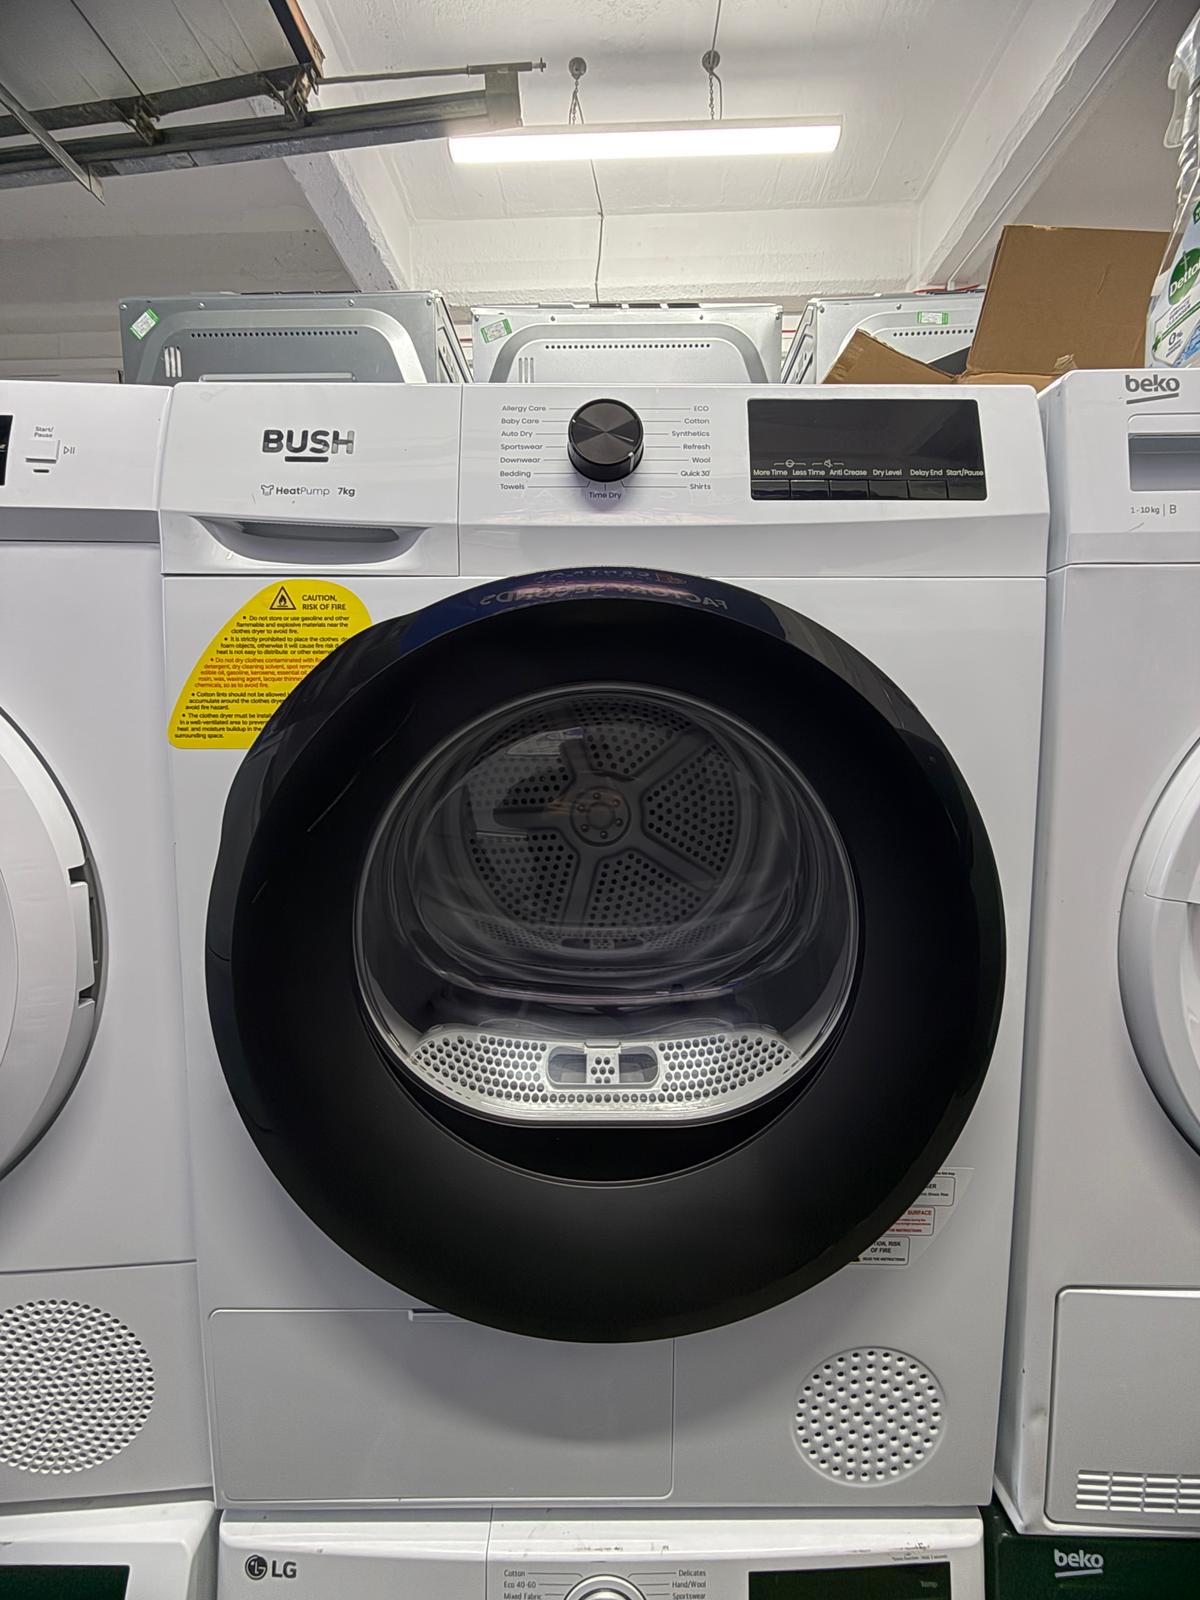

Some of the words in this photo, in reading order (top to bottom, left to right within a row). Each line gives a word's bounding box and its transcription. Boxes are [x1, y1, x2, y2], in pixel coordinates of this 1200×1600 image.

[1125, 374, 1180, 392] beko
[262, 430, 355, 454] BUSH
[872, 469, 885, 477] Dry
[910, 469, 929, 477] Delay
[946, 468, 984, 476] Start/Pause
[276, 487, 330, 496] HeatPump
[337, 487, 355, 497] 7kg
[1170, 504, 1177, 514] B
[302, 595, 337, 604] CAUTION,
[1054, 1549, 1104, 1568] beko
[272, 1560, 297, 1578] LG
